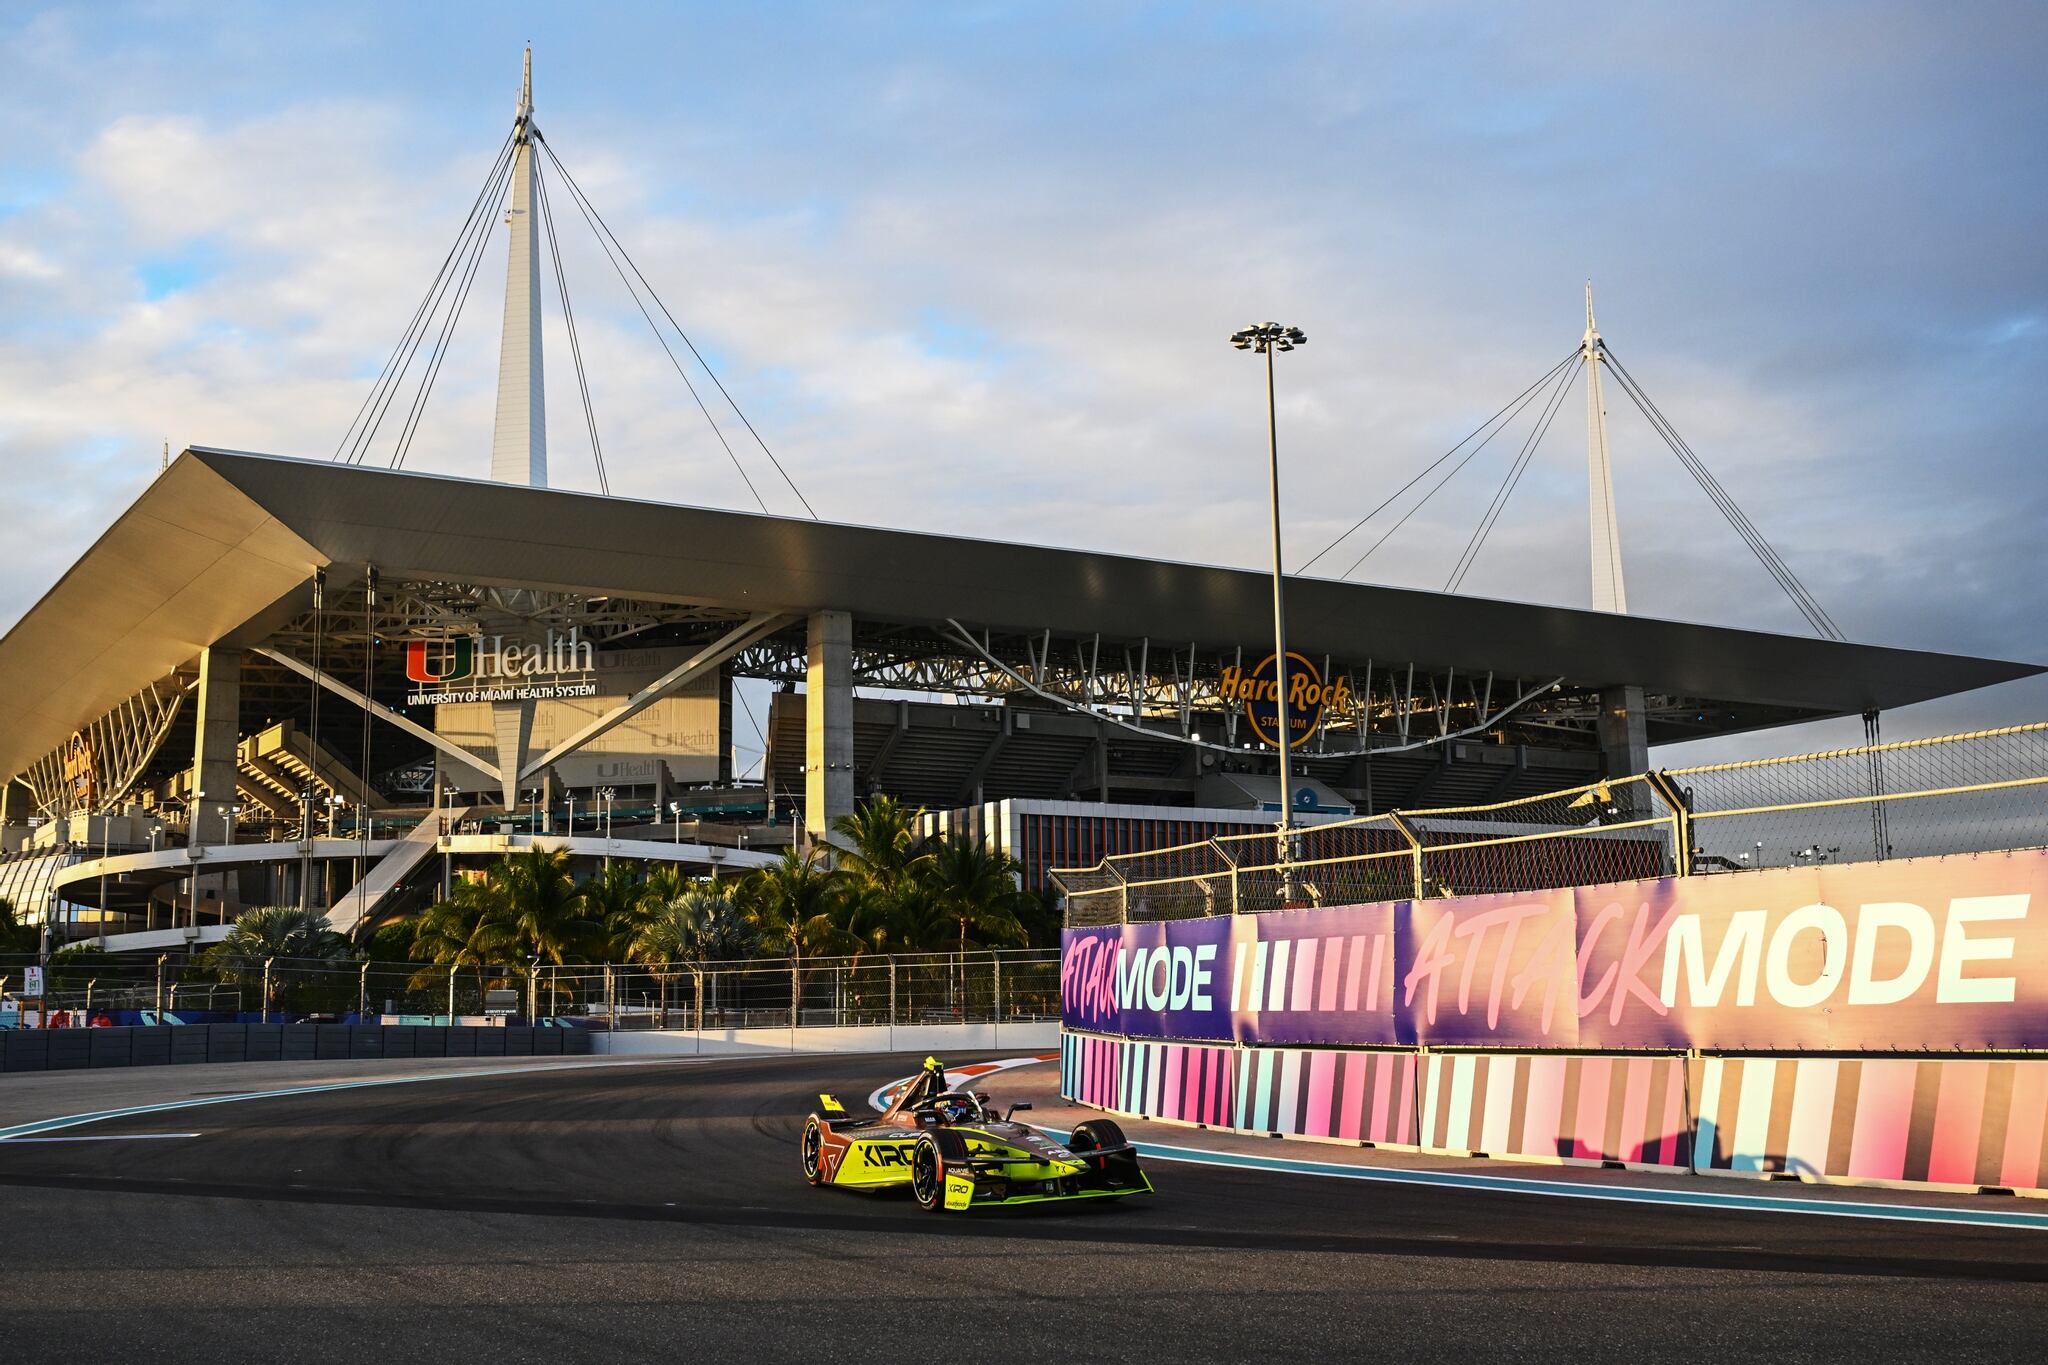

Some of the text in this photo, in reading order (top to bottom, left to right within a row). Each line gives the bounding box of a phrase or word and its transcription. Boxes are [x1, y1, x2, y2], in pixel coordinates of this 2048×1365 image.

[408, 693, 464, 706] UNIVERSITY
[466, 691, 480, 703] OF
[481, 689, 514, 701] MIAMI
[517, 687, 552, 699] HEALTH
[556, 685, 596, 697] SYSTEM
[1289, 673, 1350, 713] Rock
[1261, 717, 1306, 729] STAUM
[1061, 935, 1218, 1023] ATTACK MODE
[1404, 893, 2031, 1035] ATTACK MODE
